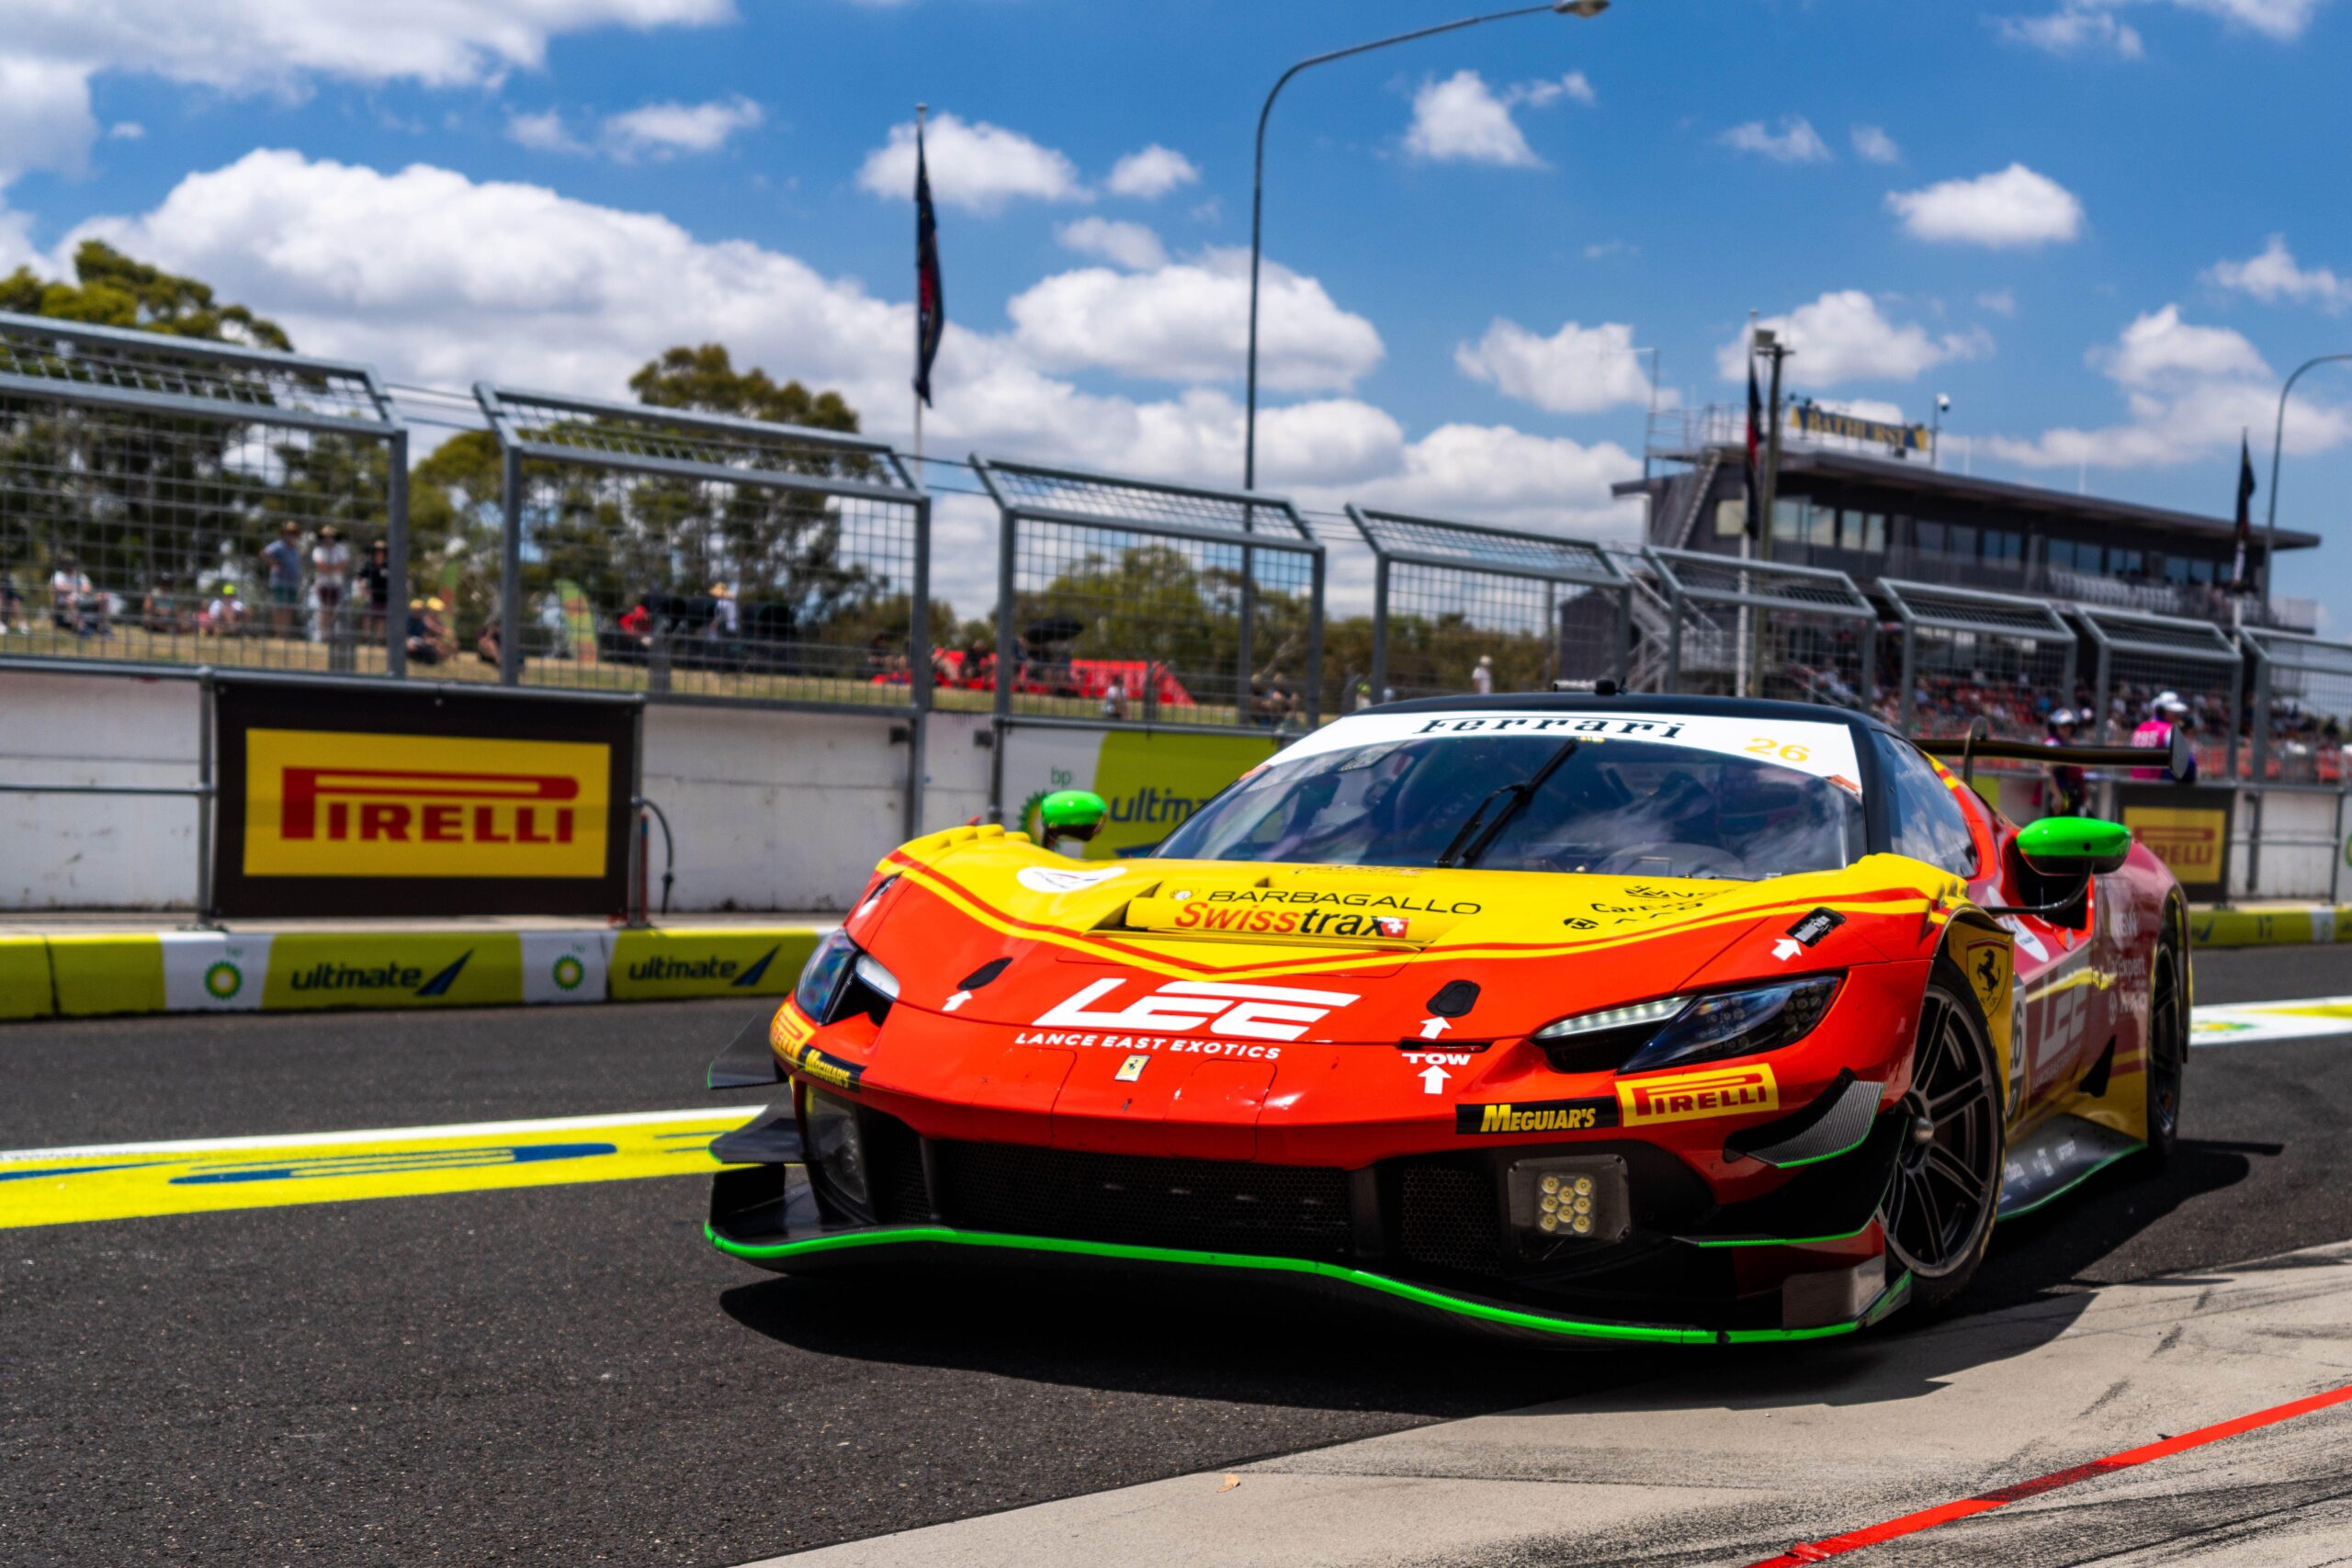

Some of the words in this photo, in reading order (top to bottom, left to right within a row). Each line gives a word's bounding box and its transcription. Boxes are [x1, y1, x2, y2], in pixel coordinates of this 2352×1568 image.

[1412, 716, 1685, 739] Ferrari
[1743, 737, 1811, 762] 26
[1051, 767, 1072, 787] bp
[280, 766, 579, 844] PIRELLI
[1207, 890, 1482, 915] BARBAGALLO
[1174, 901, 1385, 938] Swisstrax
[290, 962, 422, 990] ultimate
[628, 955, 738, 981] ultimate
[1031, 977, 1362, 1041] LEE
[1014, 1032, 1094, 1046] LANCE
[1101, 1036, 1166, 1050] EAST
[1170, 1039, 1281, 1059] EXOTICS
[1402, 1053, 1470, 1066] TOW
[1632, 1072, 1767, 1117] PIRELLI
[1480, 1104, 1596, 1133] MEGUIAR'S
